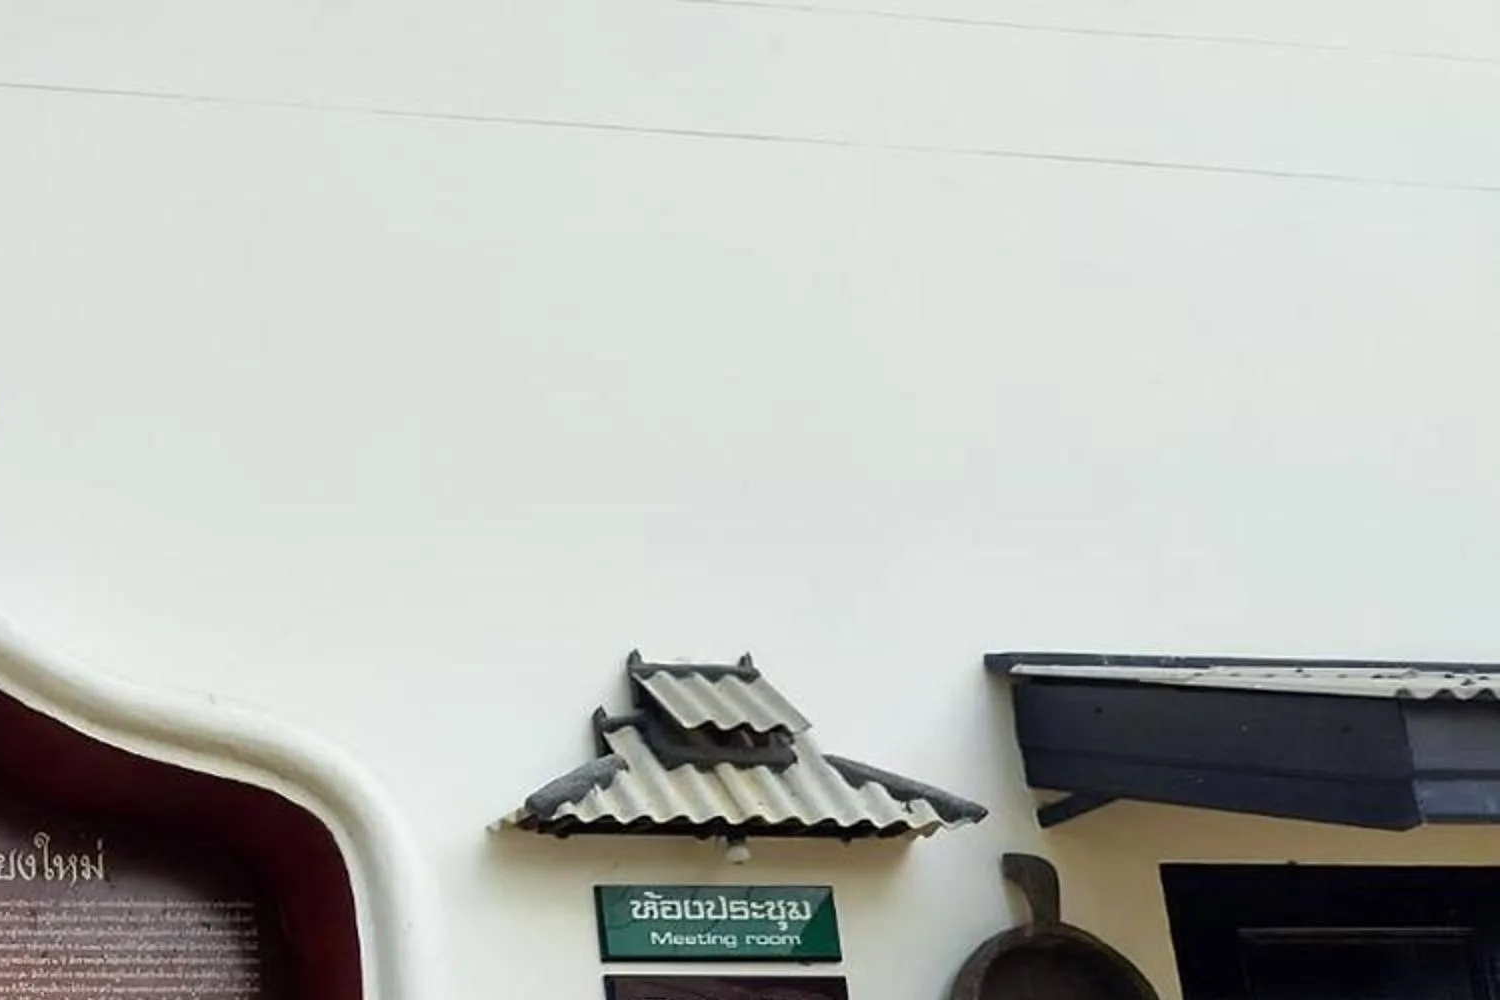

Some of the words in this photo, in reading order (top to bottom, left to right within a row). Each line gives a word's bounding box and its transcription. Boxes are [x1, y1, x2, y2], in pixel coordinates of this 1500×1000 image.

[630, 891, 811, 931] ห้องประชุม
[651, 932, 737, 948] Meeting
[745, 933, 801, 945] room
